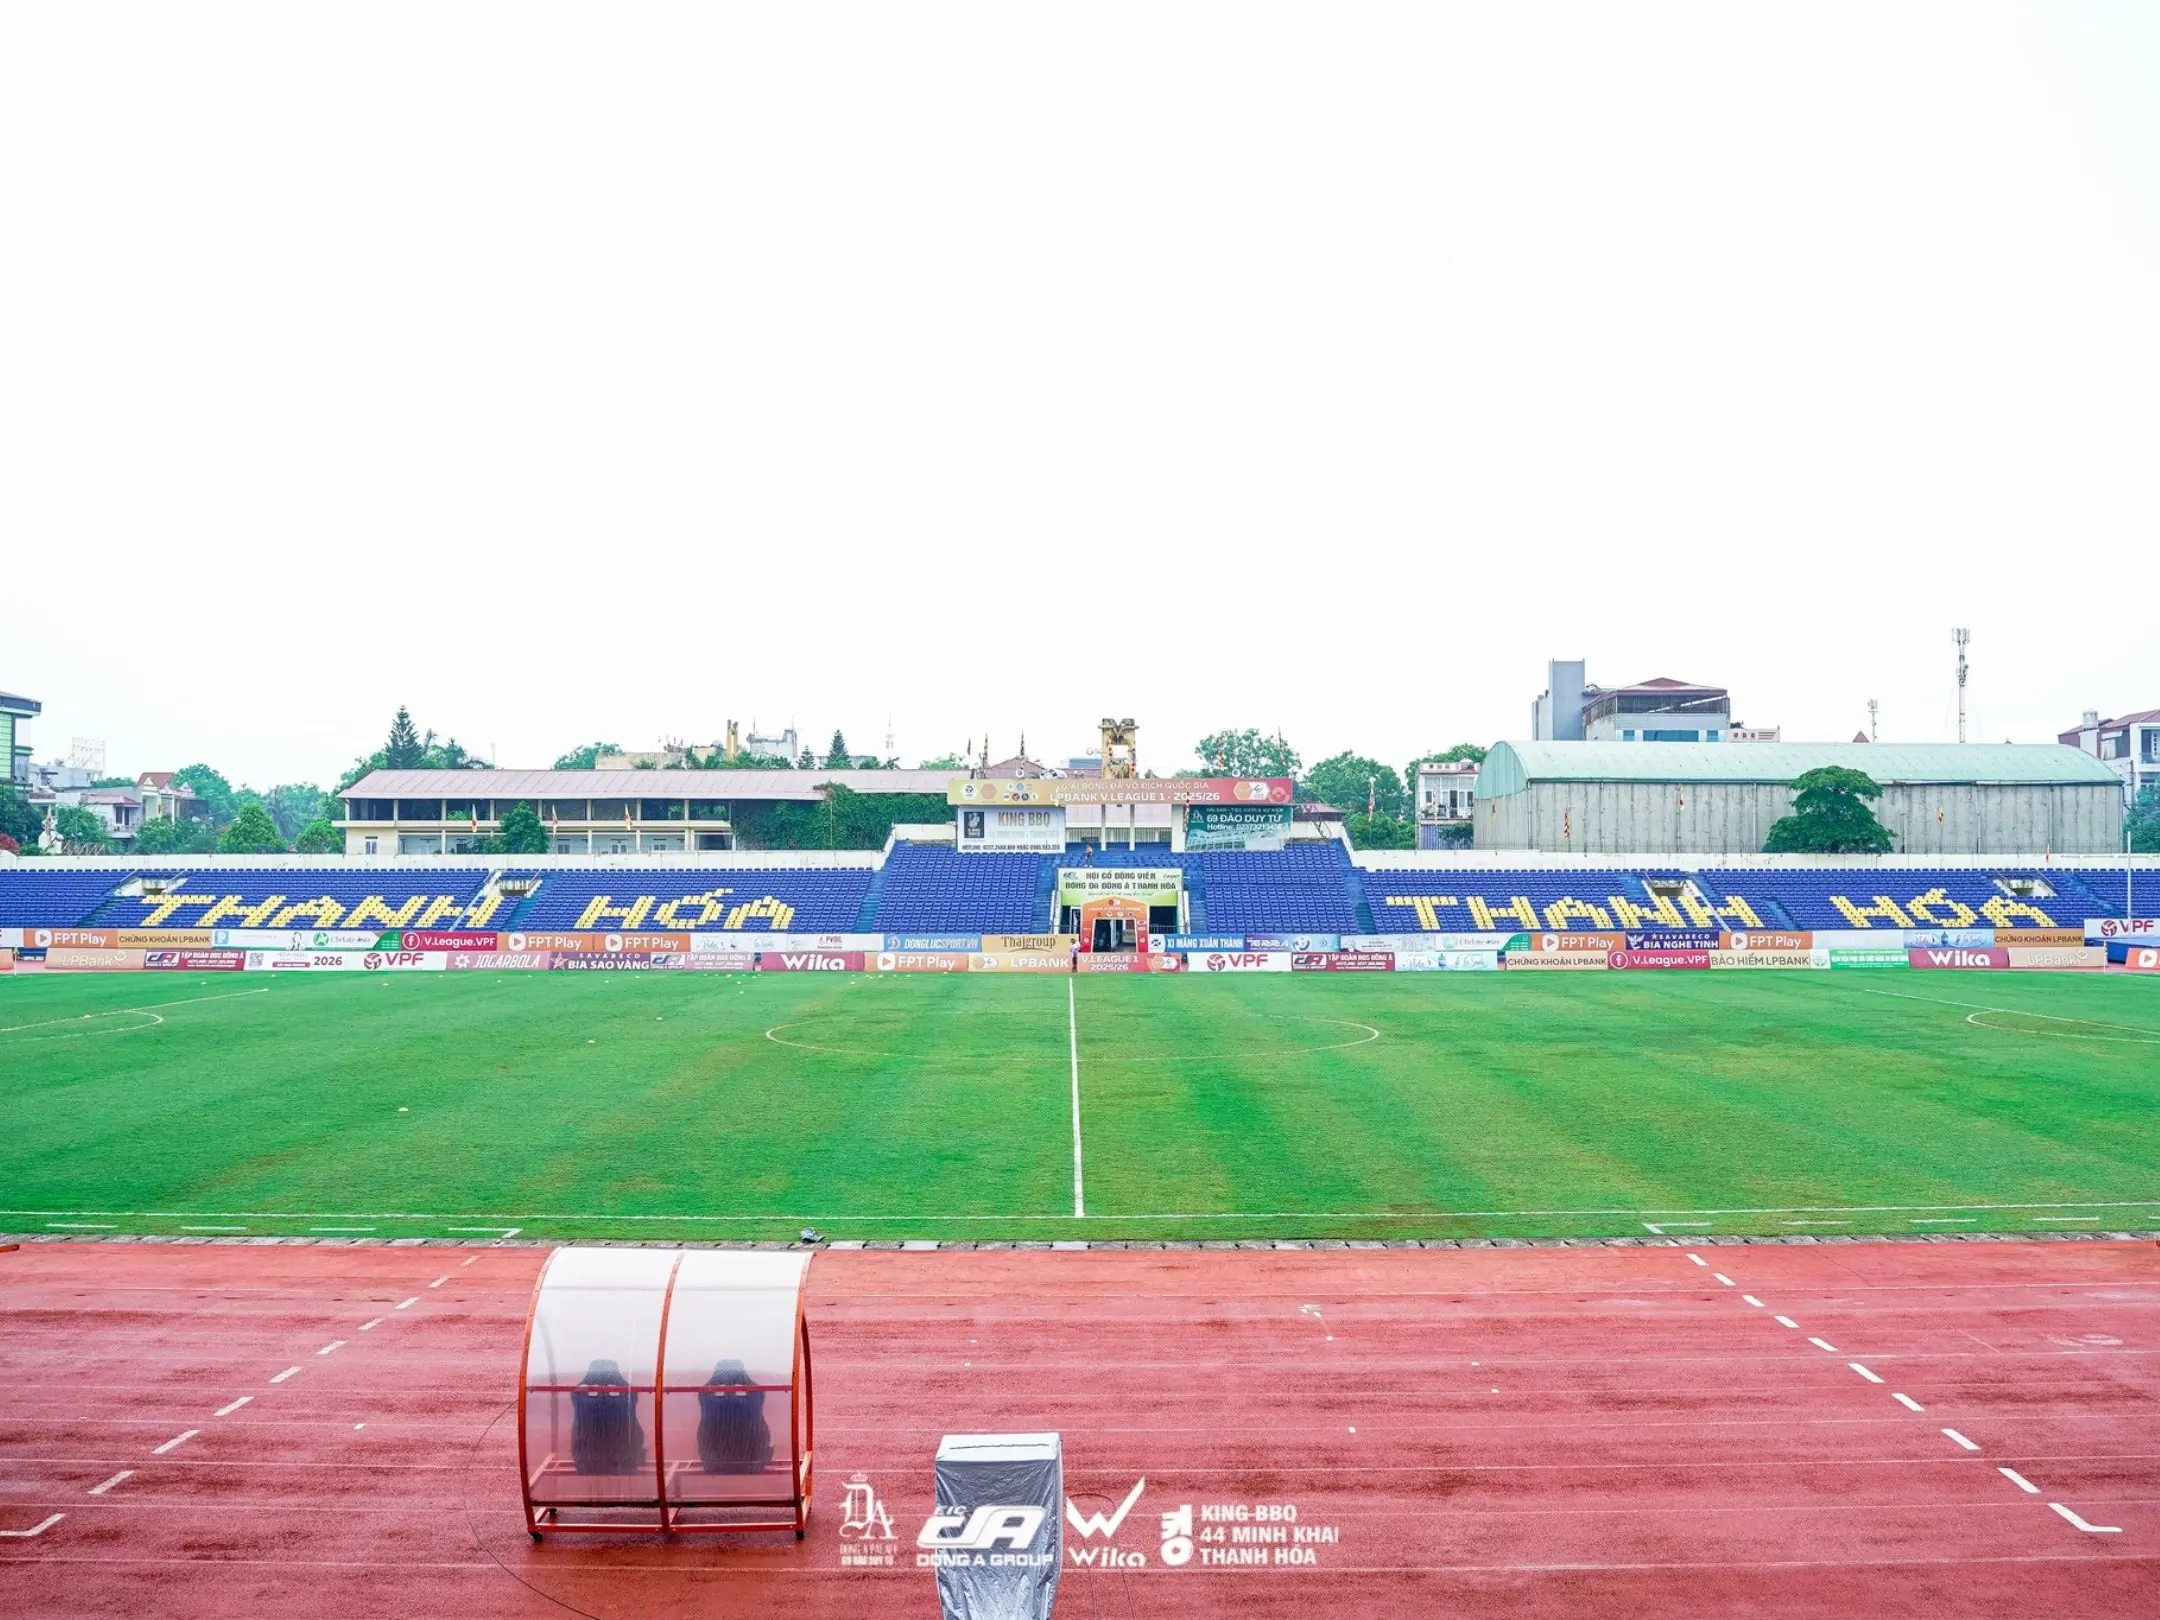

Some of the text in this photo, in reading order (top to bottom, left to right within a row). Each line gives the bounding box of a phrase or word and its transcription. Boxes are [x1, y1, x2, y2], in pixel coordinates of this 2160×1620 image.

[1100, 792, 1157, 802] V.LEAGUE
[1159, 792, 1164, 801] 1
[998, 811, 1051, 828] KING BBQ
[1207, 814, 1218, 823] 69
[1245, 814, 1266, 823] DUY
[1132, 882, 1158, 890] THANH
[140, 888, 795, 929] THANH HÓA
[1386, 895, 1765, 929] THANH
[2120, 919, 2154, 933] VPF
[54, 932, 107, 947] FPT Play
[179, 935, 211, 943] LPBANK
[424, 936, 496, 948] V.League.VPF
[528, 936, 582, 951] FPT Play
[625, 937, 680, 951] FPT Play
[1001, 935, 1056, 950] Thaigroup
[1167, 937, 1176, 949] XI
[1561, 936, 1615, 950] FPT Play
[1643, 940, 1661, 949] BIA
[1750, 935, 1802, 949] FPT Play
[2053, 935, 2082, 943] LPBANK
[62, 955, 112, 966] LPBank
[314, 956, 343, 966] 2026
[385, 952, 424, 966] VPF
[568, 957, 650, 970] BIA SAO VÀNG
[780, 953, 846, 970] Wika
[898, 956, 956, 971] FPT Play
[1010, 958, 1070, 968] LPBANK
[1081, 954, 1139, 964] V.LEAGUE 1
[1228, 953, 1268, 967] VPF
[1508, 955, 1539, 966] CHỨNG
[1572, 958, 1606, 967] LPBANK
[1633, 955, 1708, 967] V.League.VPF
[1766, 956, 1809, 965] LPBANK
[1927, 950, 1991, 967] Wika
[2027, 953, 2077, 966] LPBank
[1090, 963, 1129, 971] 2025/26
